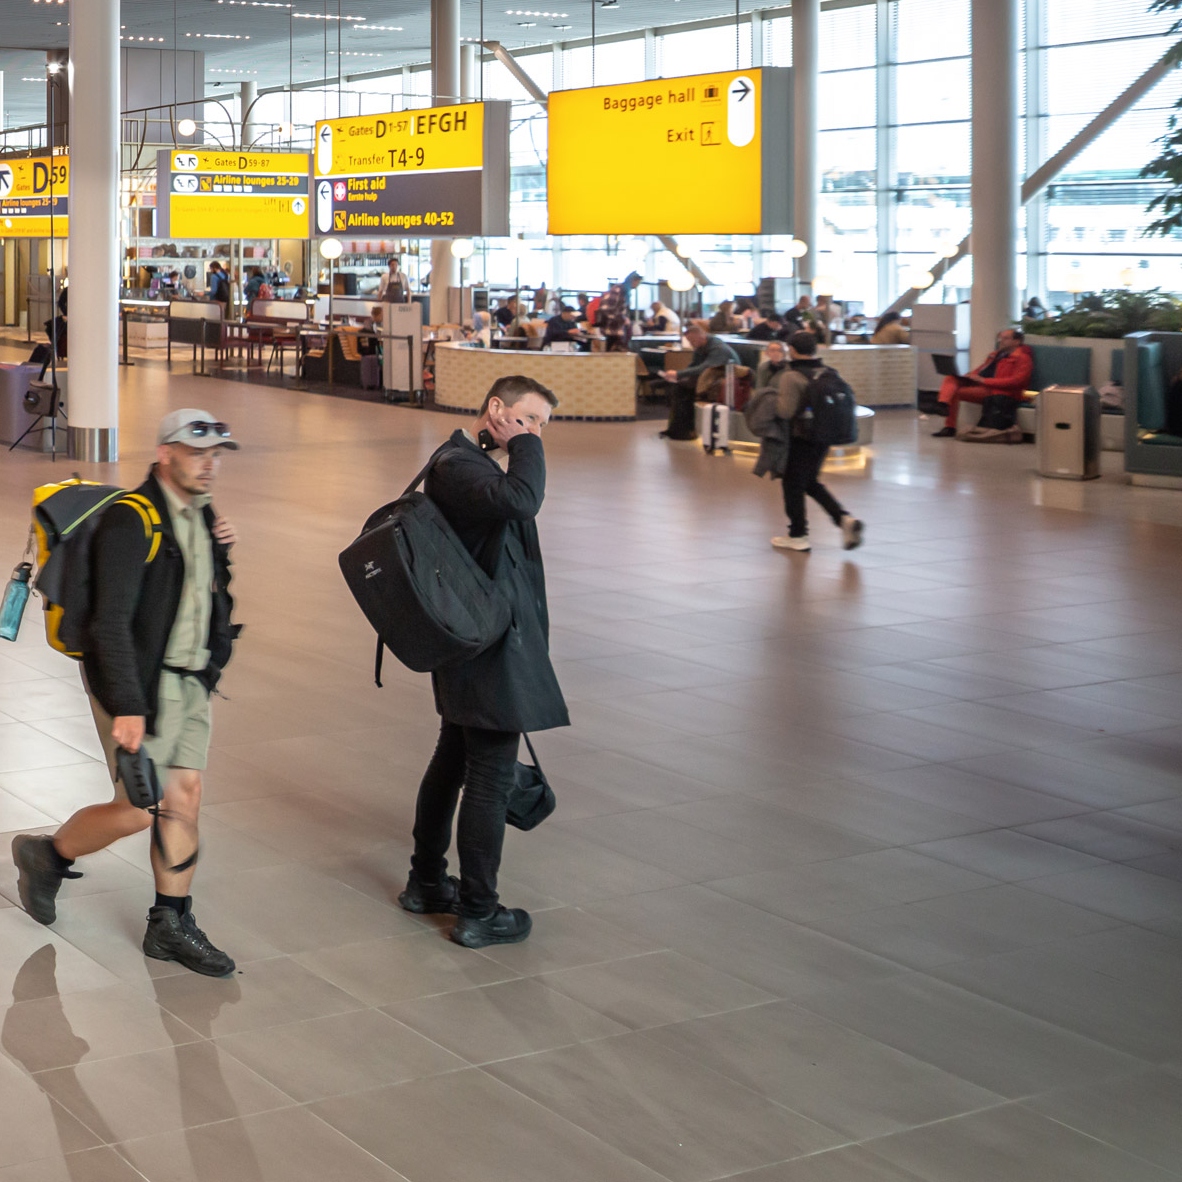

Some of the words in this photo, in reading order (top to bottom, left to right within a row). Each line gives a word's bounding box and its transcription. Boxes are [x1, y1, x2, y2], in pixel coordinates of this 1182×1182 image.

[604, 94, 663, 112] Baggage
[668, 87, 695, 103] hall
[348, 125, 373, 137] Gates
[667, 127, 694, 143] Exit
[214, 158, 236, 167] Gates
[348, 154, 385, 166] Transfer
[388, 147, 425, 168] T4-9
[213, 174, 241, 185] Airline
[243, 175, 275, 187] lounges
[348, 178, 368, 191] First
[370, 176, 386, 190] aid
[16, 184, 31, 192] Gates
[1, 199, 19, 207] Airline
[19, 198, 42, 208] lounges
[348, 213, 380, 227] Airline
[381, 213, 422, 229] lounges
[423, 211, 454, 226] 40-52
